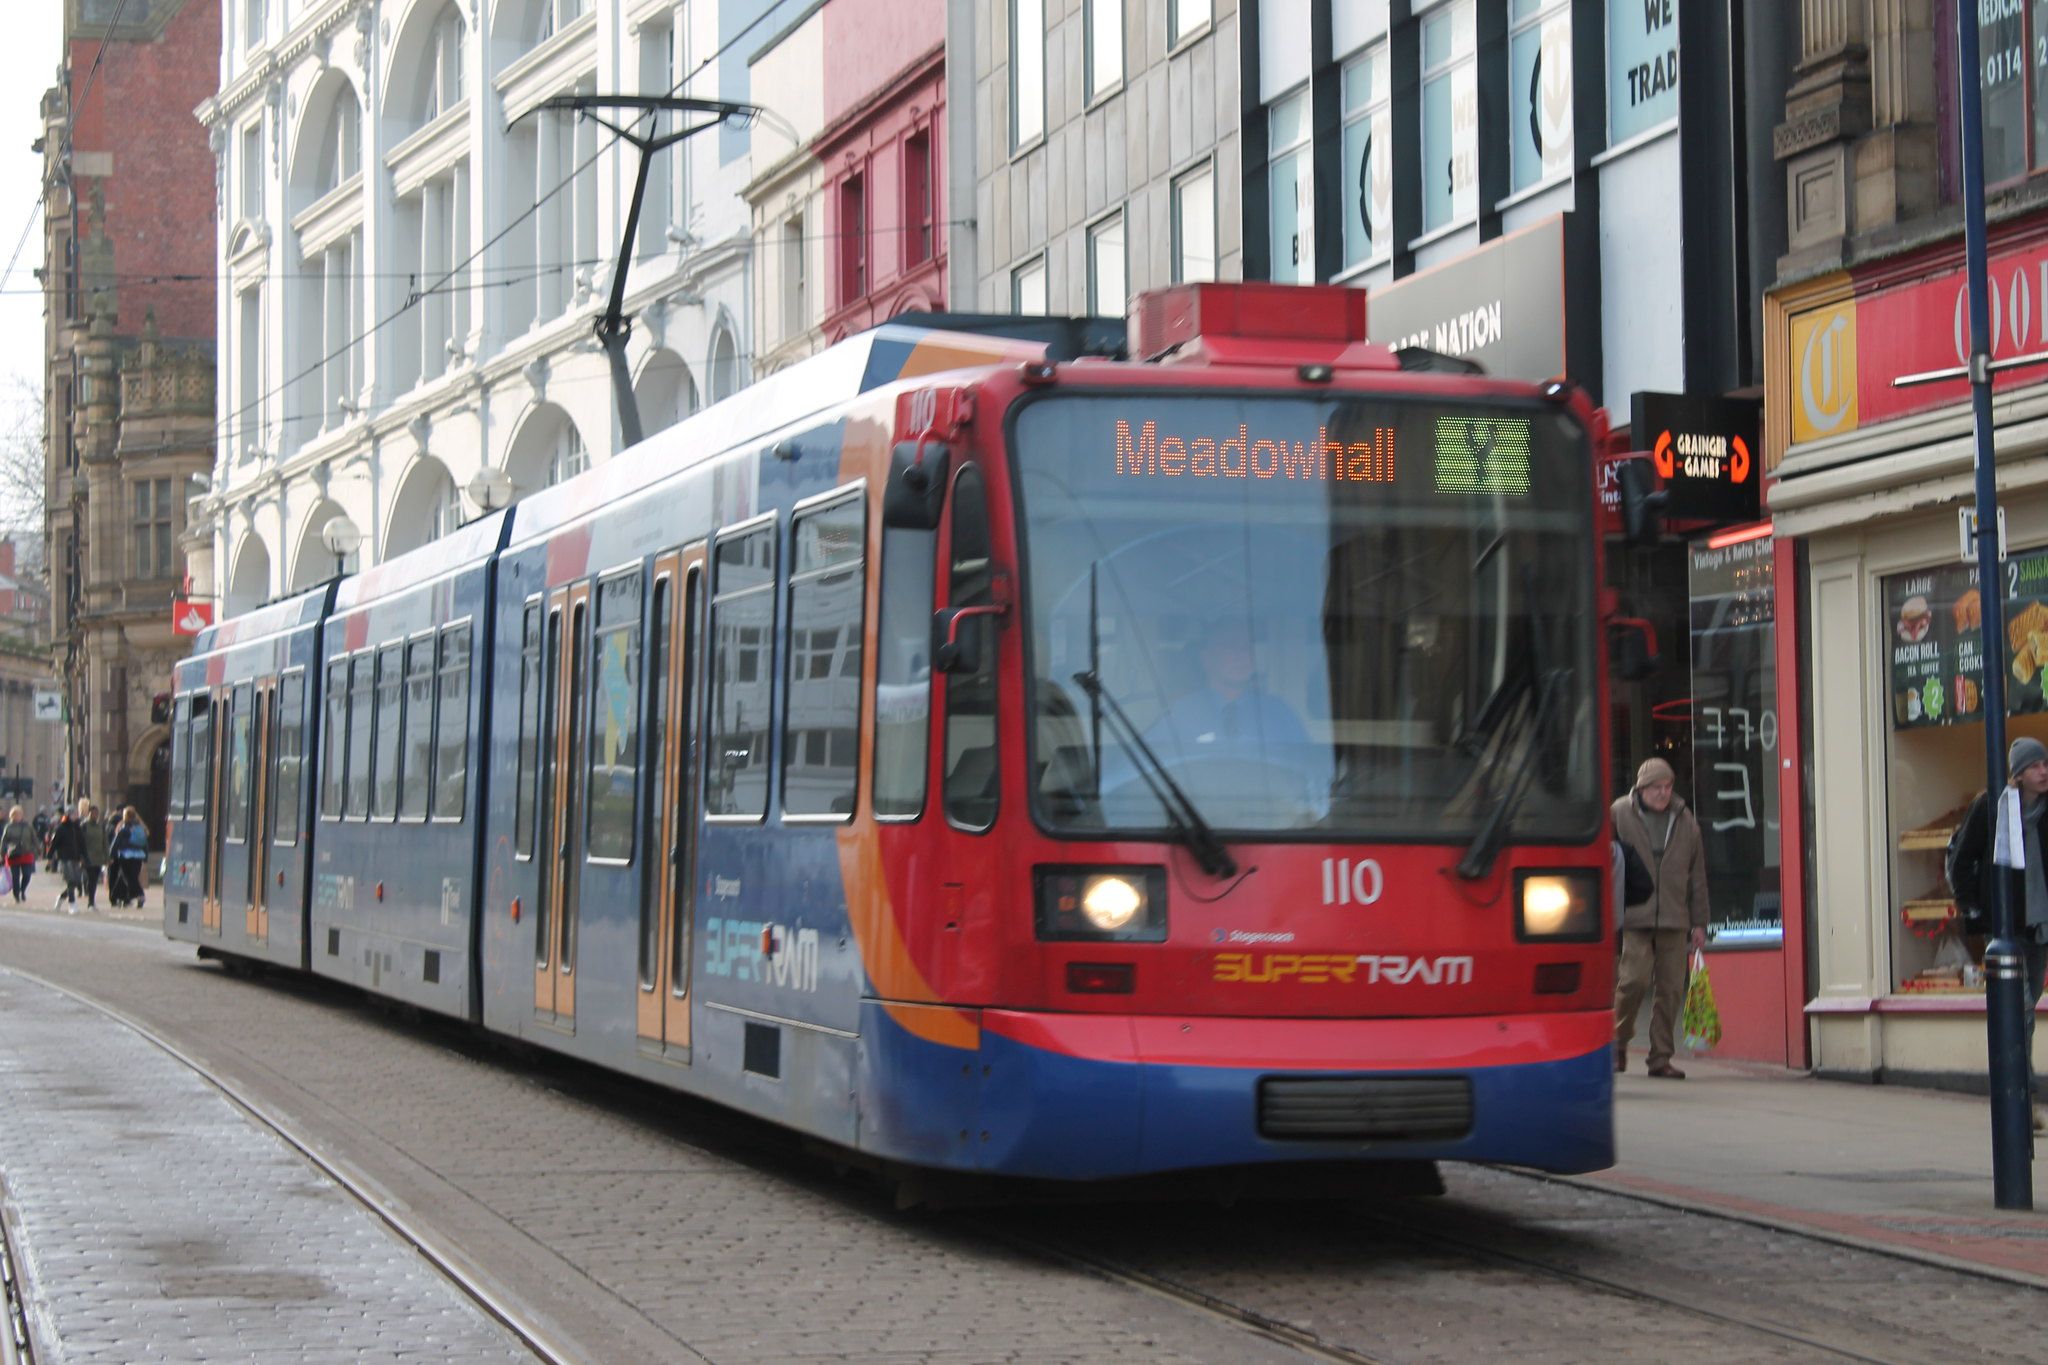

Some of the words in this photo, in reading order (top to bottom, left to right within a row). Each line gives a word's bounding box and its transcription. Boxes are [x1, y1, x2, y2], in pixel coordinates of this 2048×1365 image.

[1644, 0, 1672, 35] WE
[1987, 45, 2022, 87] 0114
[1435, 299, 1502, 357] NATION
[1114, 418, 1396, 484] Meadowhall
[1676, 432, 1728, 458] GRAINGER
[1683, 456, 1720, 480] GAMES
[1905, 577, 1932, 597] LARGE
[2007, 561, 2018, 599] 2
[1894, 645, 1920, 665] BACON
[1321, 857, 1384, 906] 110
[1211, 953, 1474, 986] SUPERTRAM
